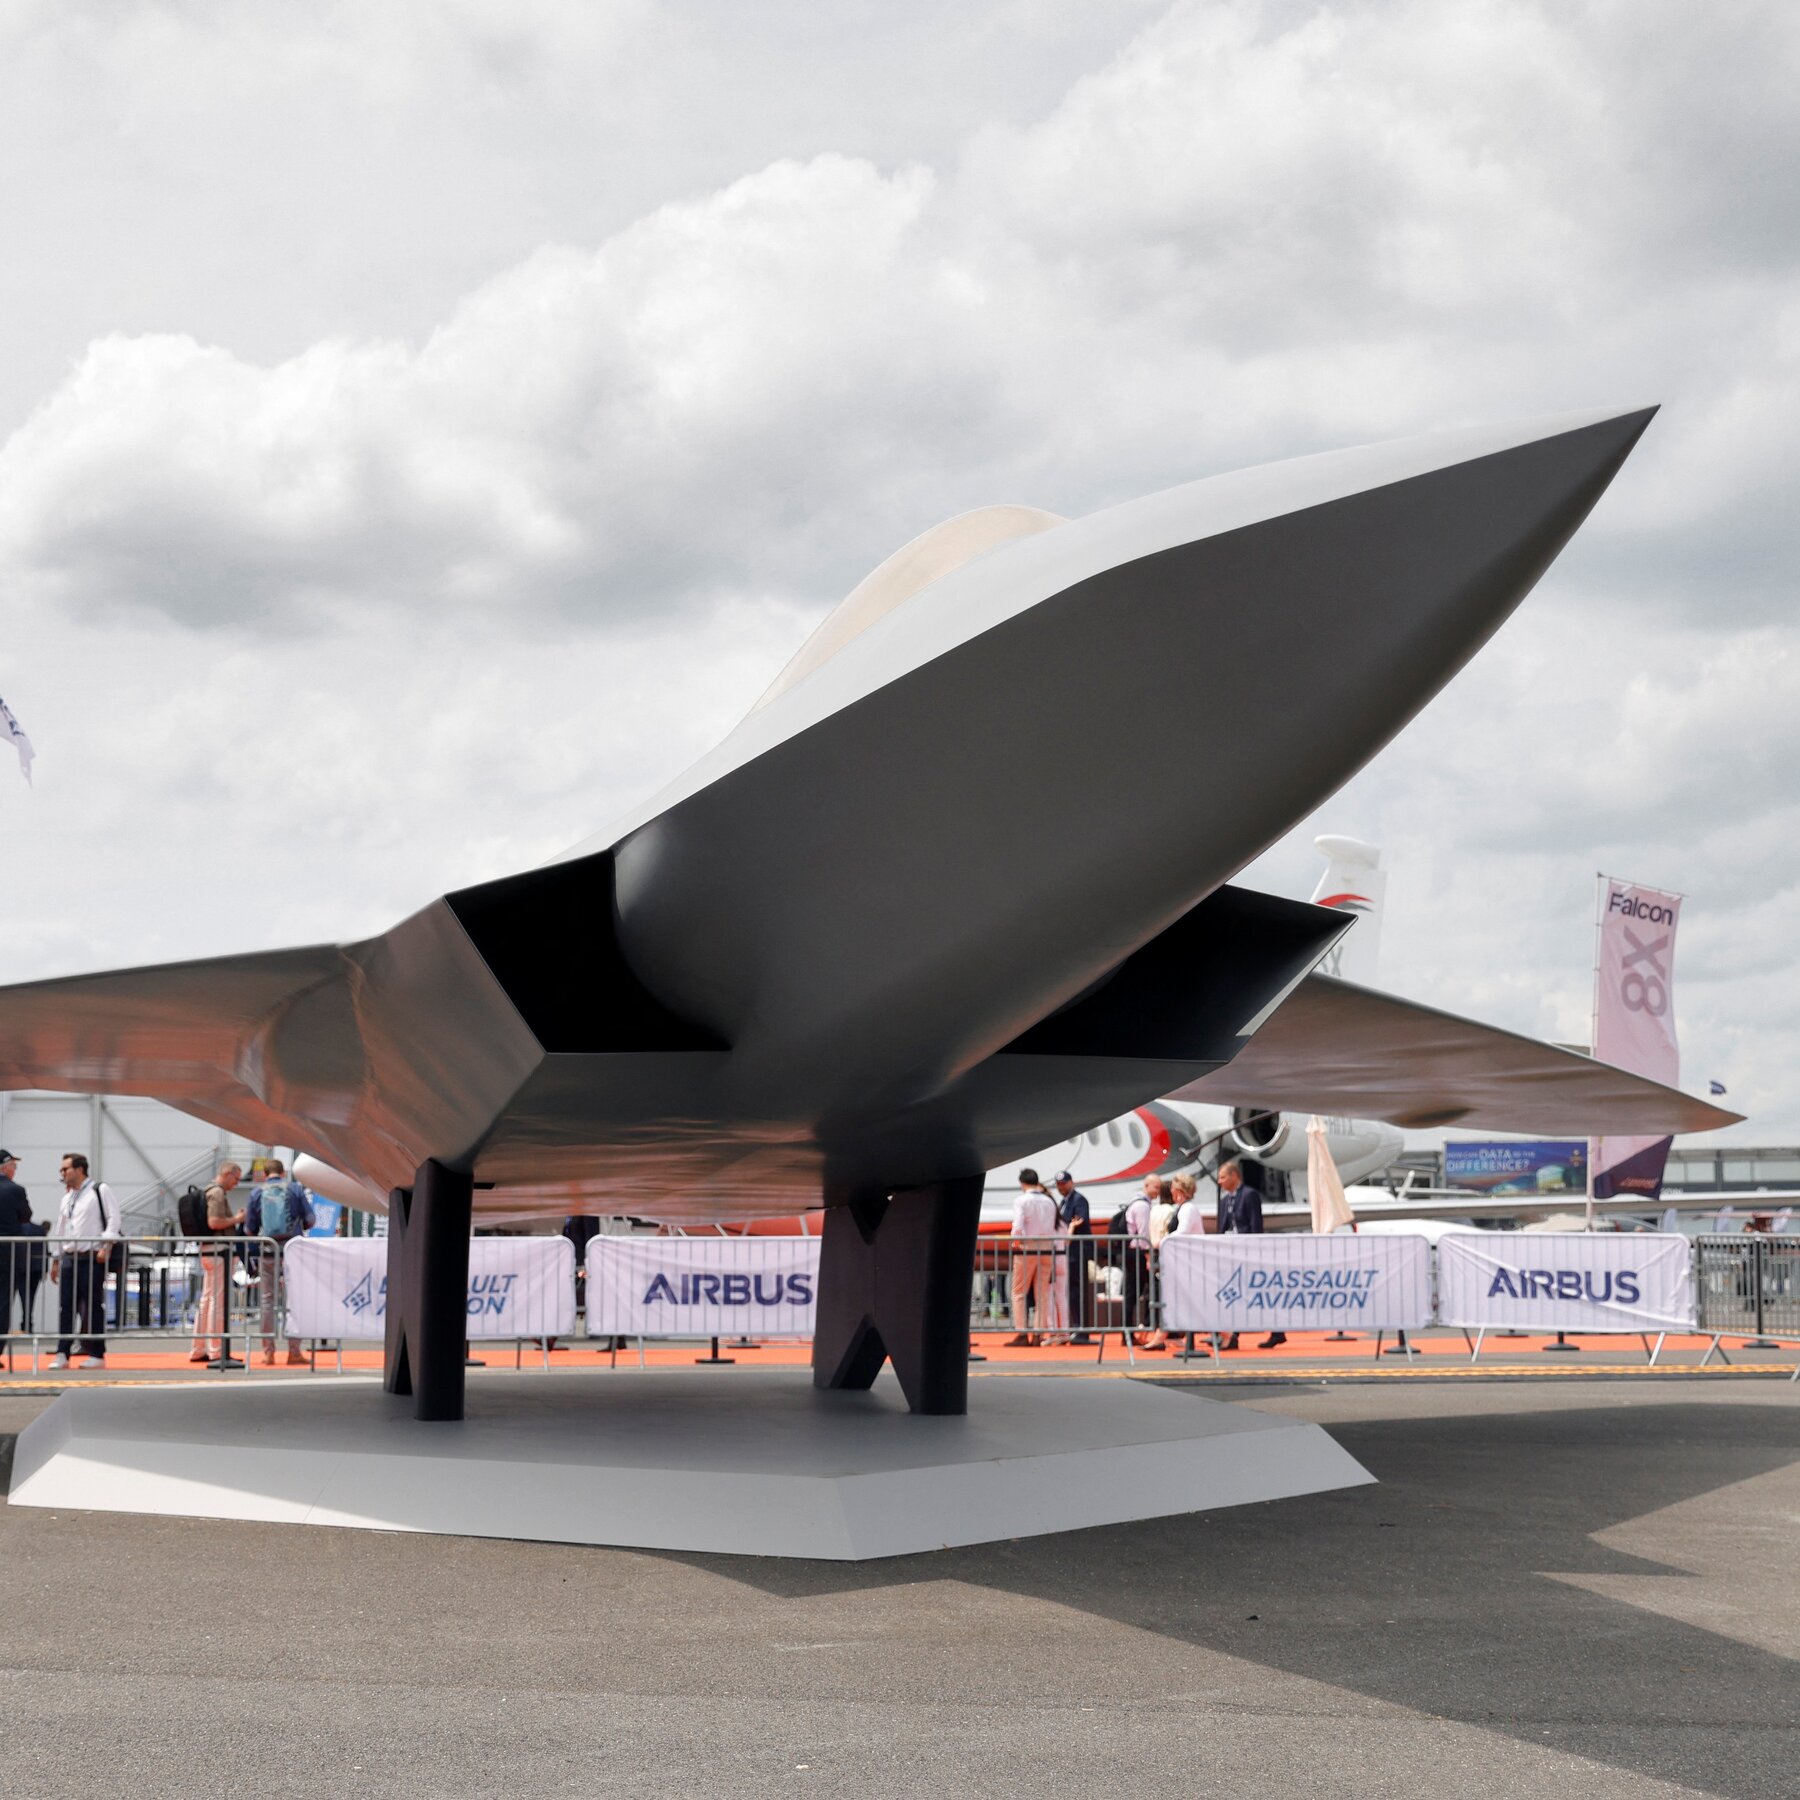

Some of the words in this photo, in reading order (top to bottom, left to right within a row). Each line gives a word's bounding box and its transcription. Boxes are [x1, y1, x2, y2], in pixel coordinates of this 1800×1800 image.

[1608, 892, 1674, 926] Falcon
[1621, 925, 1669, 1017] 8X
[1446, 1159, 1530, 1172] DIFFERENCE?
[1479, 1148, 1512, 1160] DATA
[642, 1273, 813, 1306] AIRBUS
[1249, 1270, 1378, 1289] DASSAULT
[1487, 1267, 1640, 1304] AIRBUS
[1247, 1291, 1368, 1310] AVIATION
